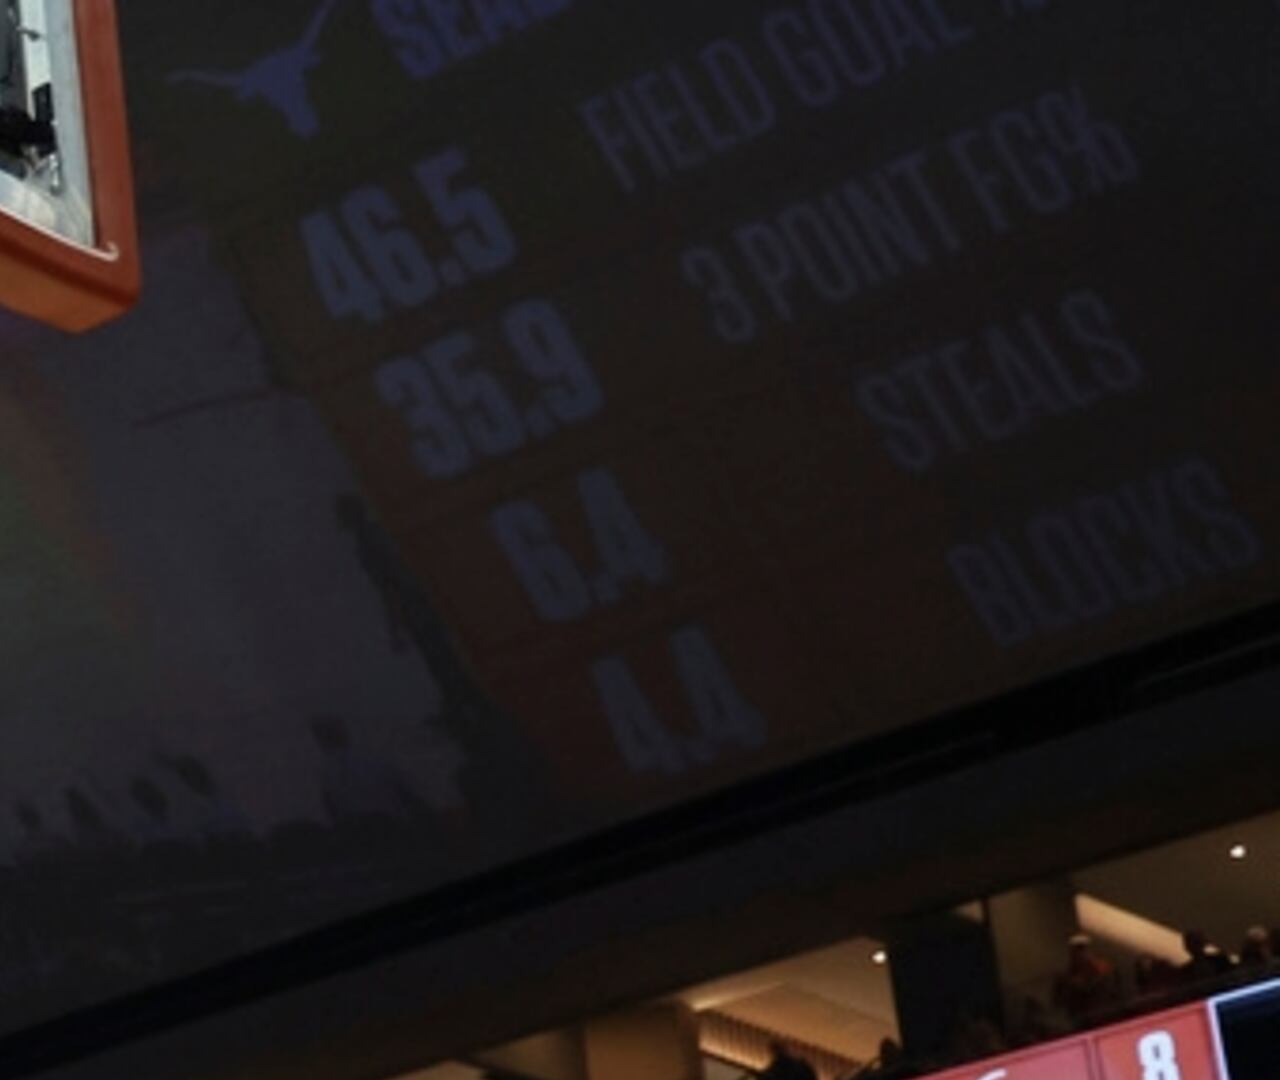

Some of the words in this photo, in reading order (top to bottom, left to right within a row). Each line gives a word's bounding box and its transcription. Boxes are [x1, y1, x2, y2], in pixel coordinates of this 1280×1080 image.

[578, 38, 778, 194] FIELD
[299, 144, 519, 322] 46.5
[680, 246, 759, 345] 3
[734, 149, 962, 323] POINT
[948, 80, 1139, 236] FG%
[374, 297, 606, 480] 35.9
[855, 287, 1146, 474] STEALS
[489, 466, 670, 623] 6.4
[946, 455, 1264, 649] BLOCKS
[590, 622, 768, 775] 4.4
